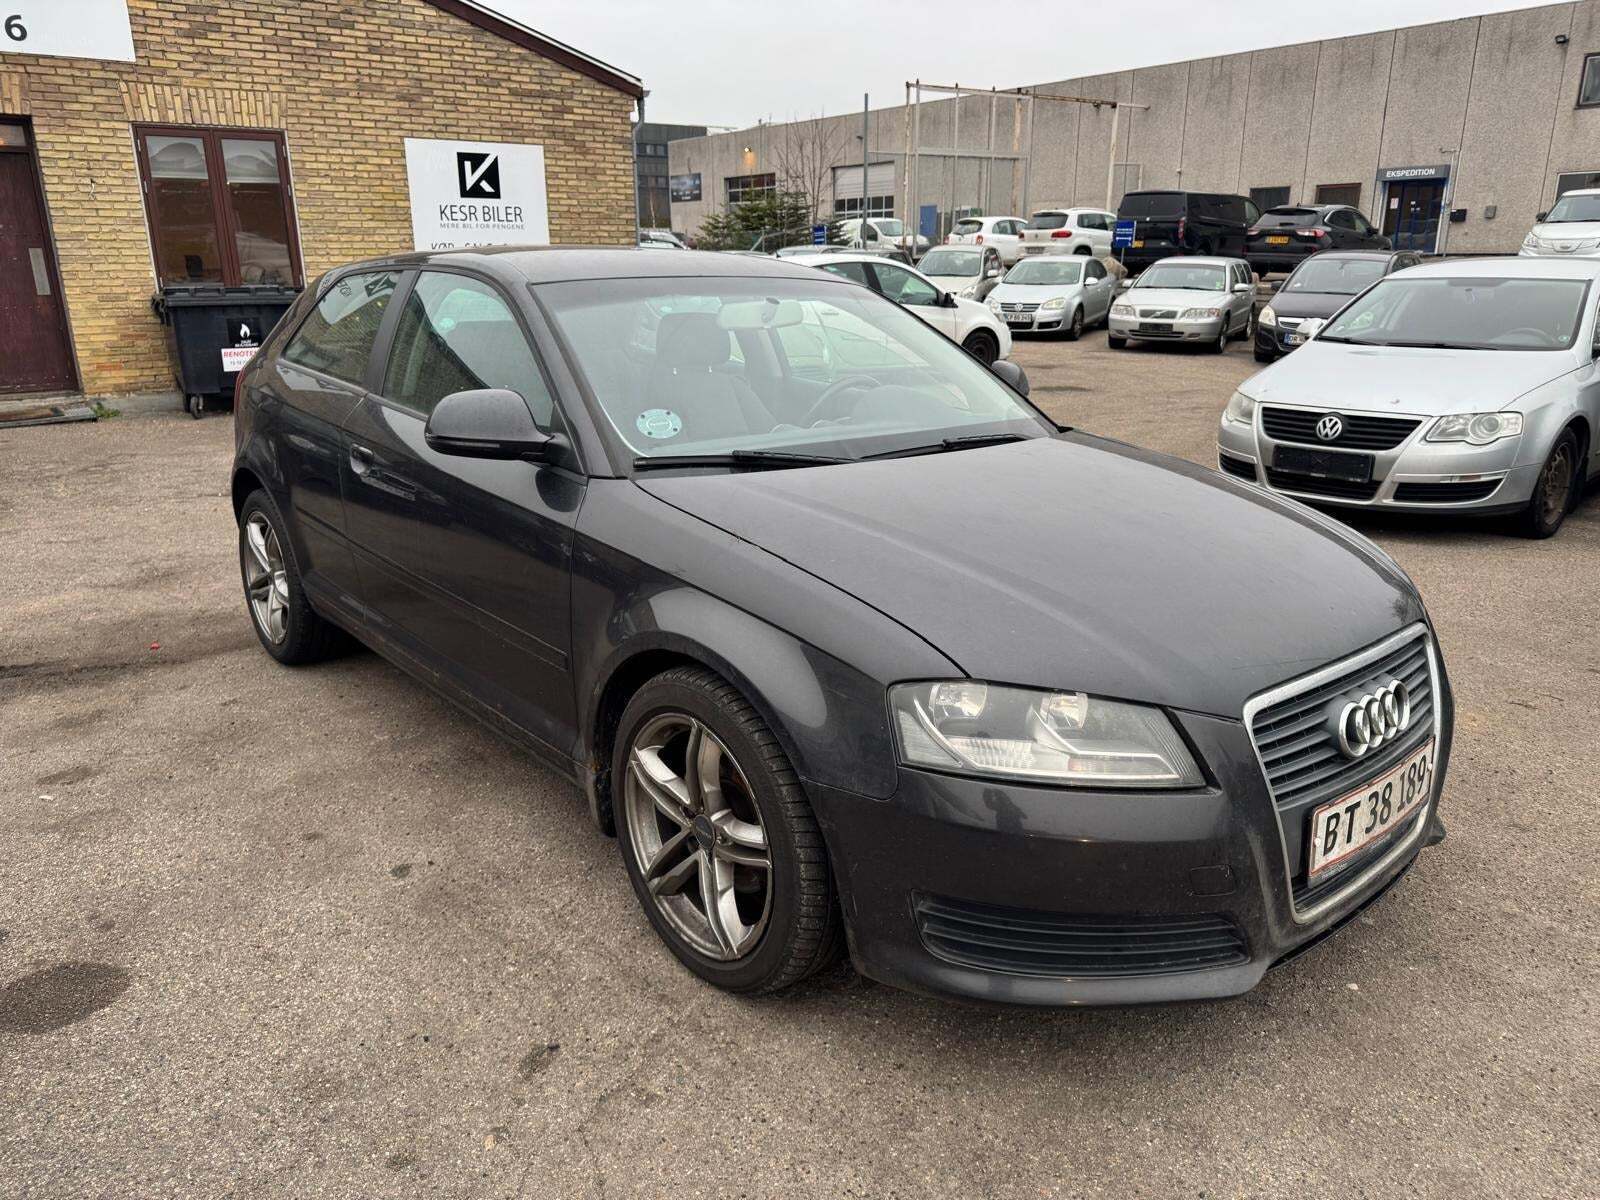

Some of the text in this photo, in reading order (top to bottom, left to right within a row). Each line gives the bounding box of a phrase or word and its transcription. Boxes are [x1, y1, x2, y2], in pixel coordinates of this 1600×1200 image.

[5, 14, 28, 42] 6
[1386, 167, 1436, 178] EKSPEDITION
[439, 204, 523, 223] KESR BILER
[223, 350, 258, 359] RENOTE
[1323, 755, 1426, 857] BT 38 189
